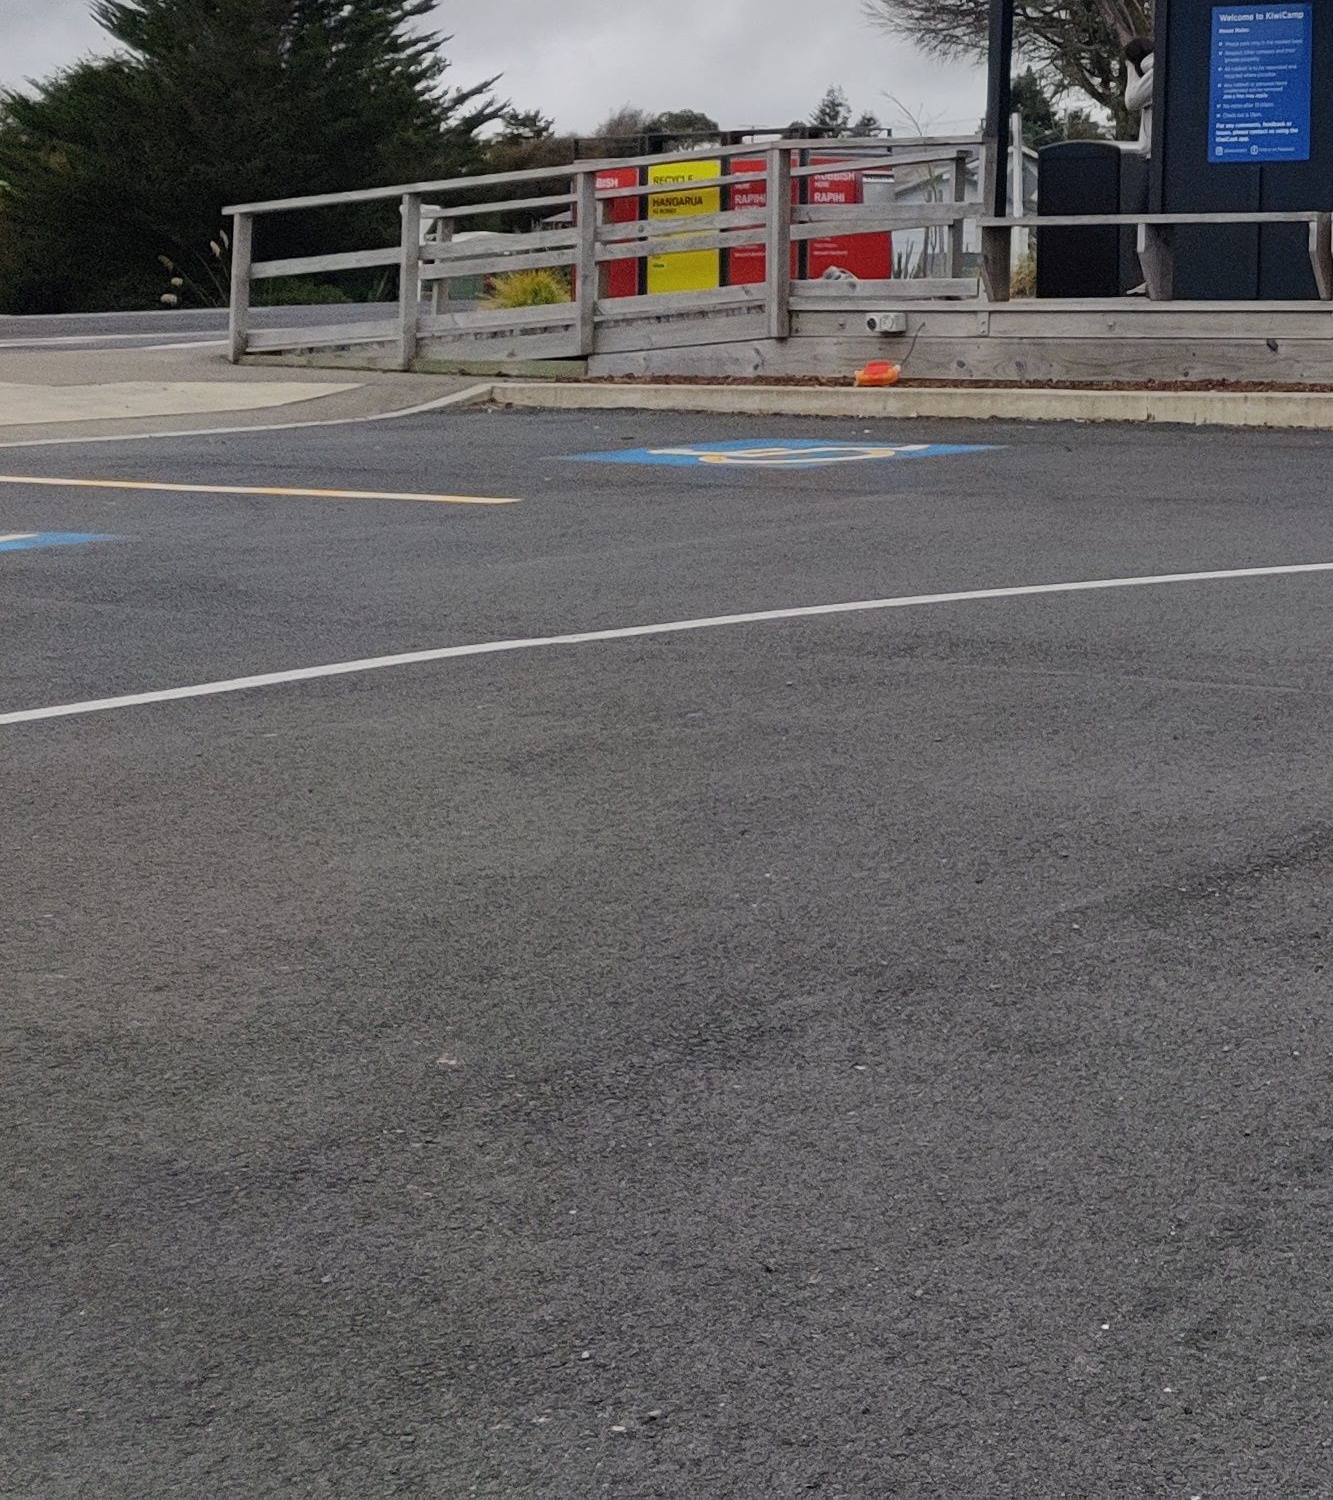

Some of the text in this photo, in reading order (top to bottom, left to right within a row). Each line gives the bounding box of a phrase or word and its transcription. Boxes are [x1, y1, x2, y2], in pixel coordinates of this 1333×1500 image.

[1219, 11, 1304, 22] Welcome to KiwiCamp
